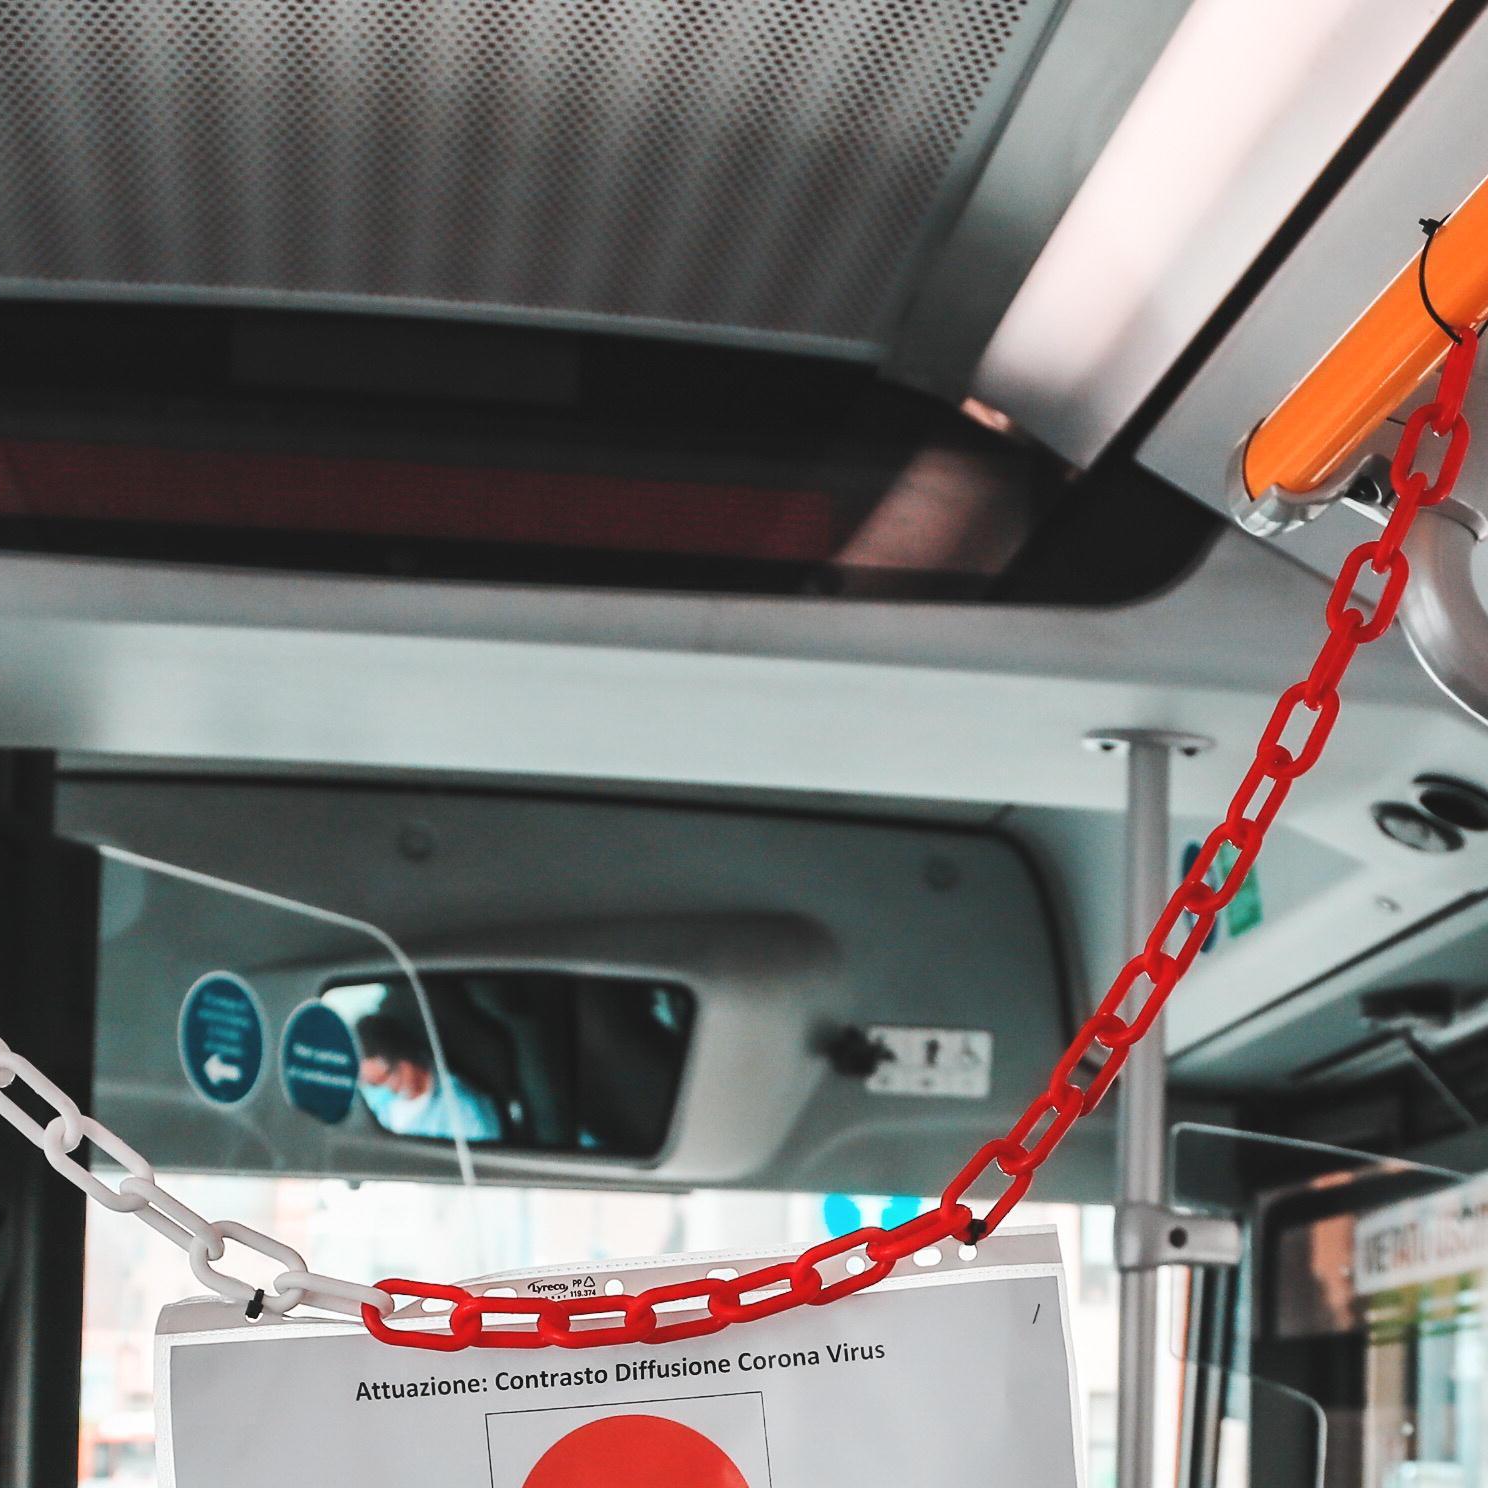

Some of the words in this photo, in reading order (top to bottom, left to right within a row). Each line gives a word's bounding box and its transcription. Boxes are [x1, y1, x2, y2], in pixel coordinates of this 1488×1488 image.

[527, 1279, 569, 1296] Lyreco
[570, 1289, 596, 1298] 119.374
[356, 1374, 488, 1402] Attuazione:
[495, 1364, 608, 1392] Contrasto
[616, 1356, 731, 1383] Diffusione
[738, 1348, 820, 1373] Corona
[827, 1341, 886, 1364] Virus
